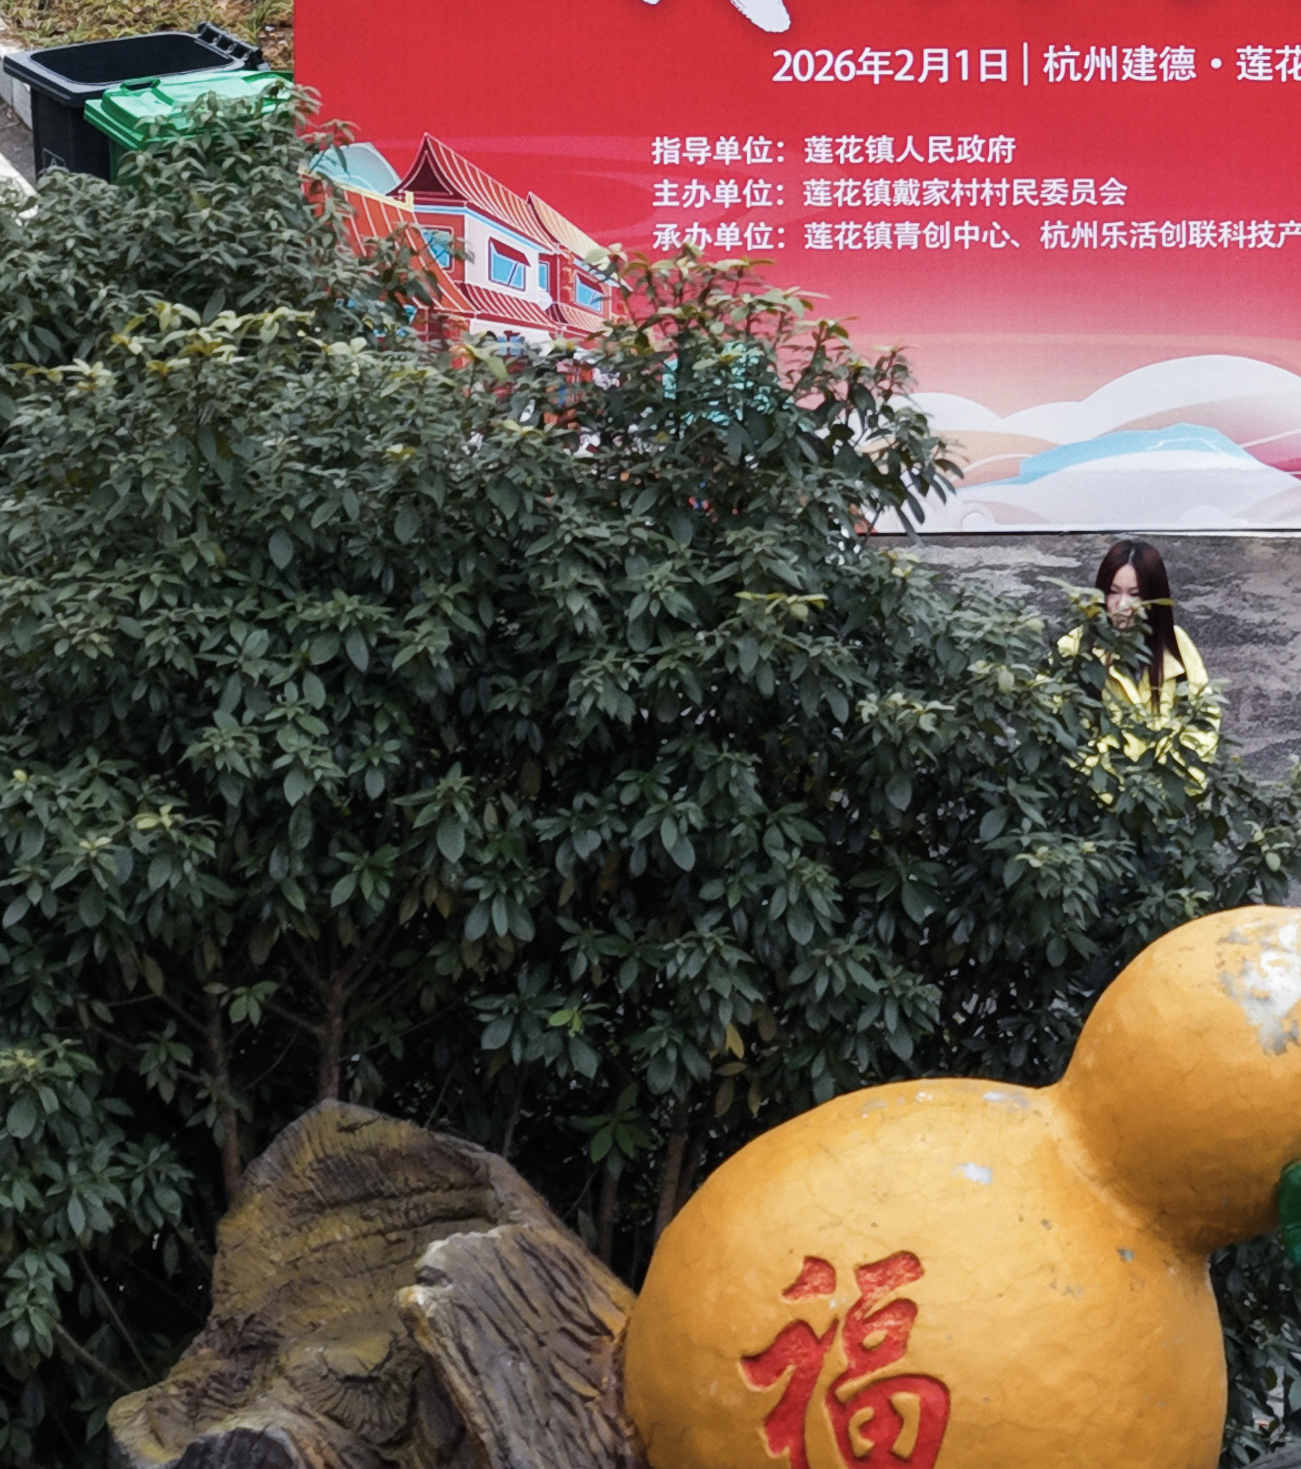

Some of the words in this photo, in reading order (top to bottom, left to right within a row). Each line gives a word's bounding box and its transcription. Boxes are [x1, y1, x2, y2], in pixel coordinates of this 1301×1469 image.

[651, 135, 1016, 166] 指导单位：莲花镇人民政府
[652, 177, 1128, 209] 主办单位：莲花镇戴家村村民委员会
[738, 1249, 951, 1469] 福
